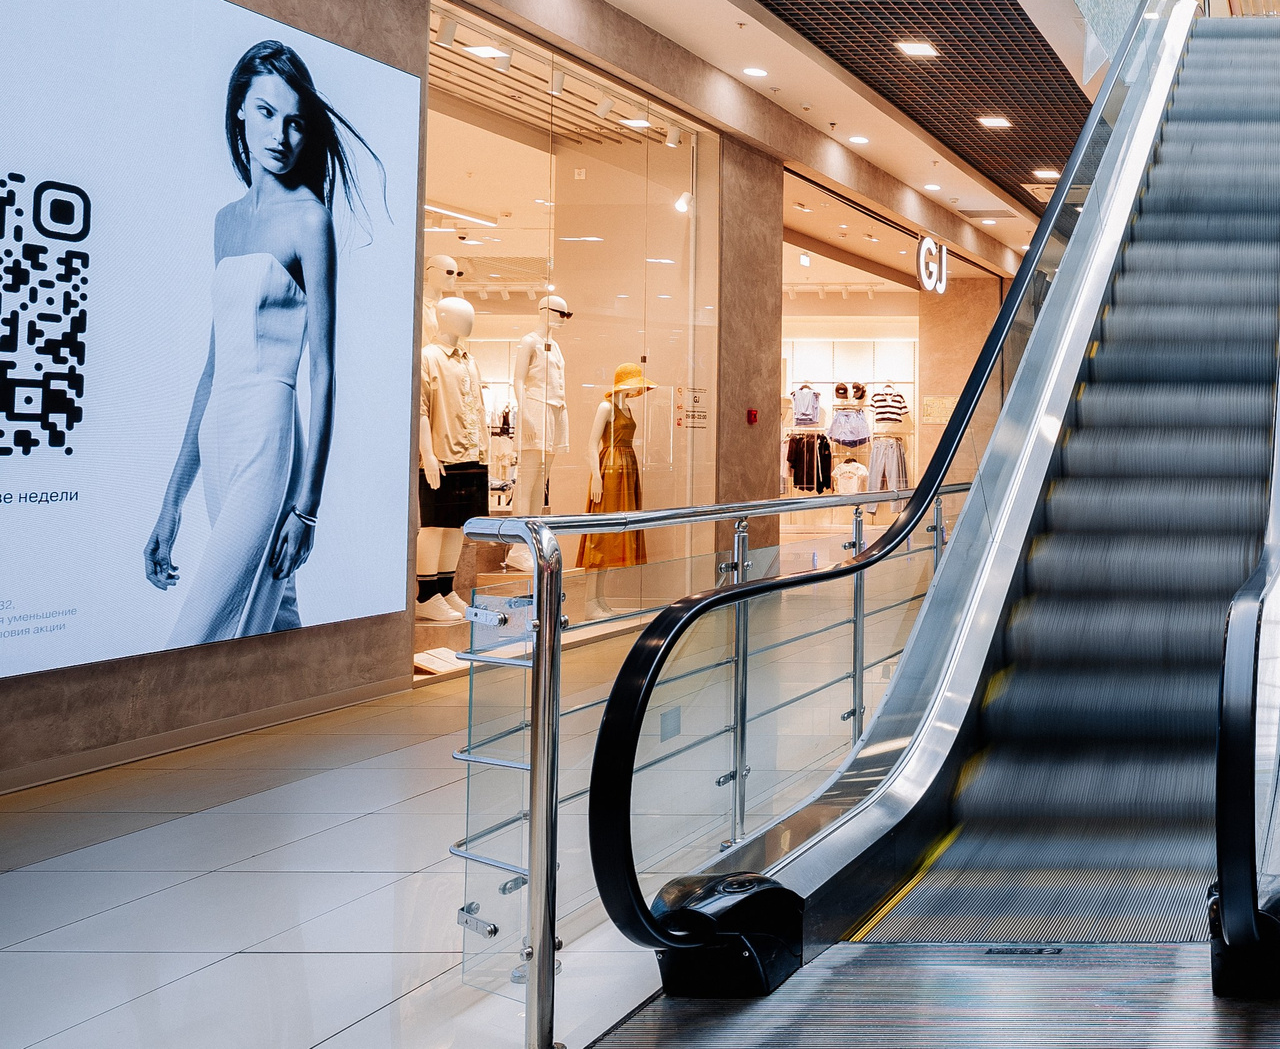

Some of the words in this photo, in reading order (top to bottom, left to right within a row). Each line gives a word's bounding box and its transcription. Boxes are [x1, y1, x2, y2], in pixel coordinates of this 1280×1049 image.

[917, 236, 947, 294] GJ
[0, 492, 13, 504] е
[18, 491, 79, 504] недели
[7, 608, 77, 626] уменьшение
[33, 623, 66, 634] акции
